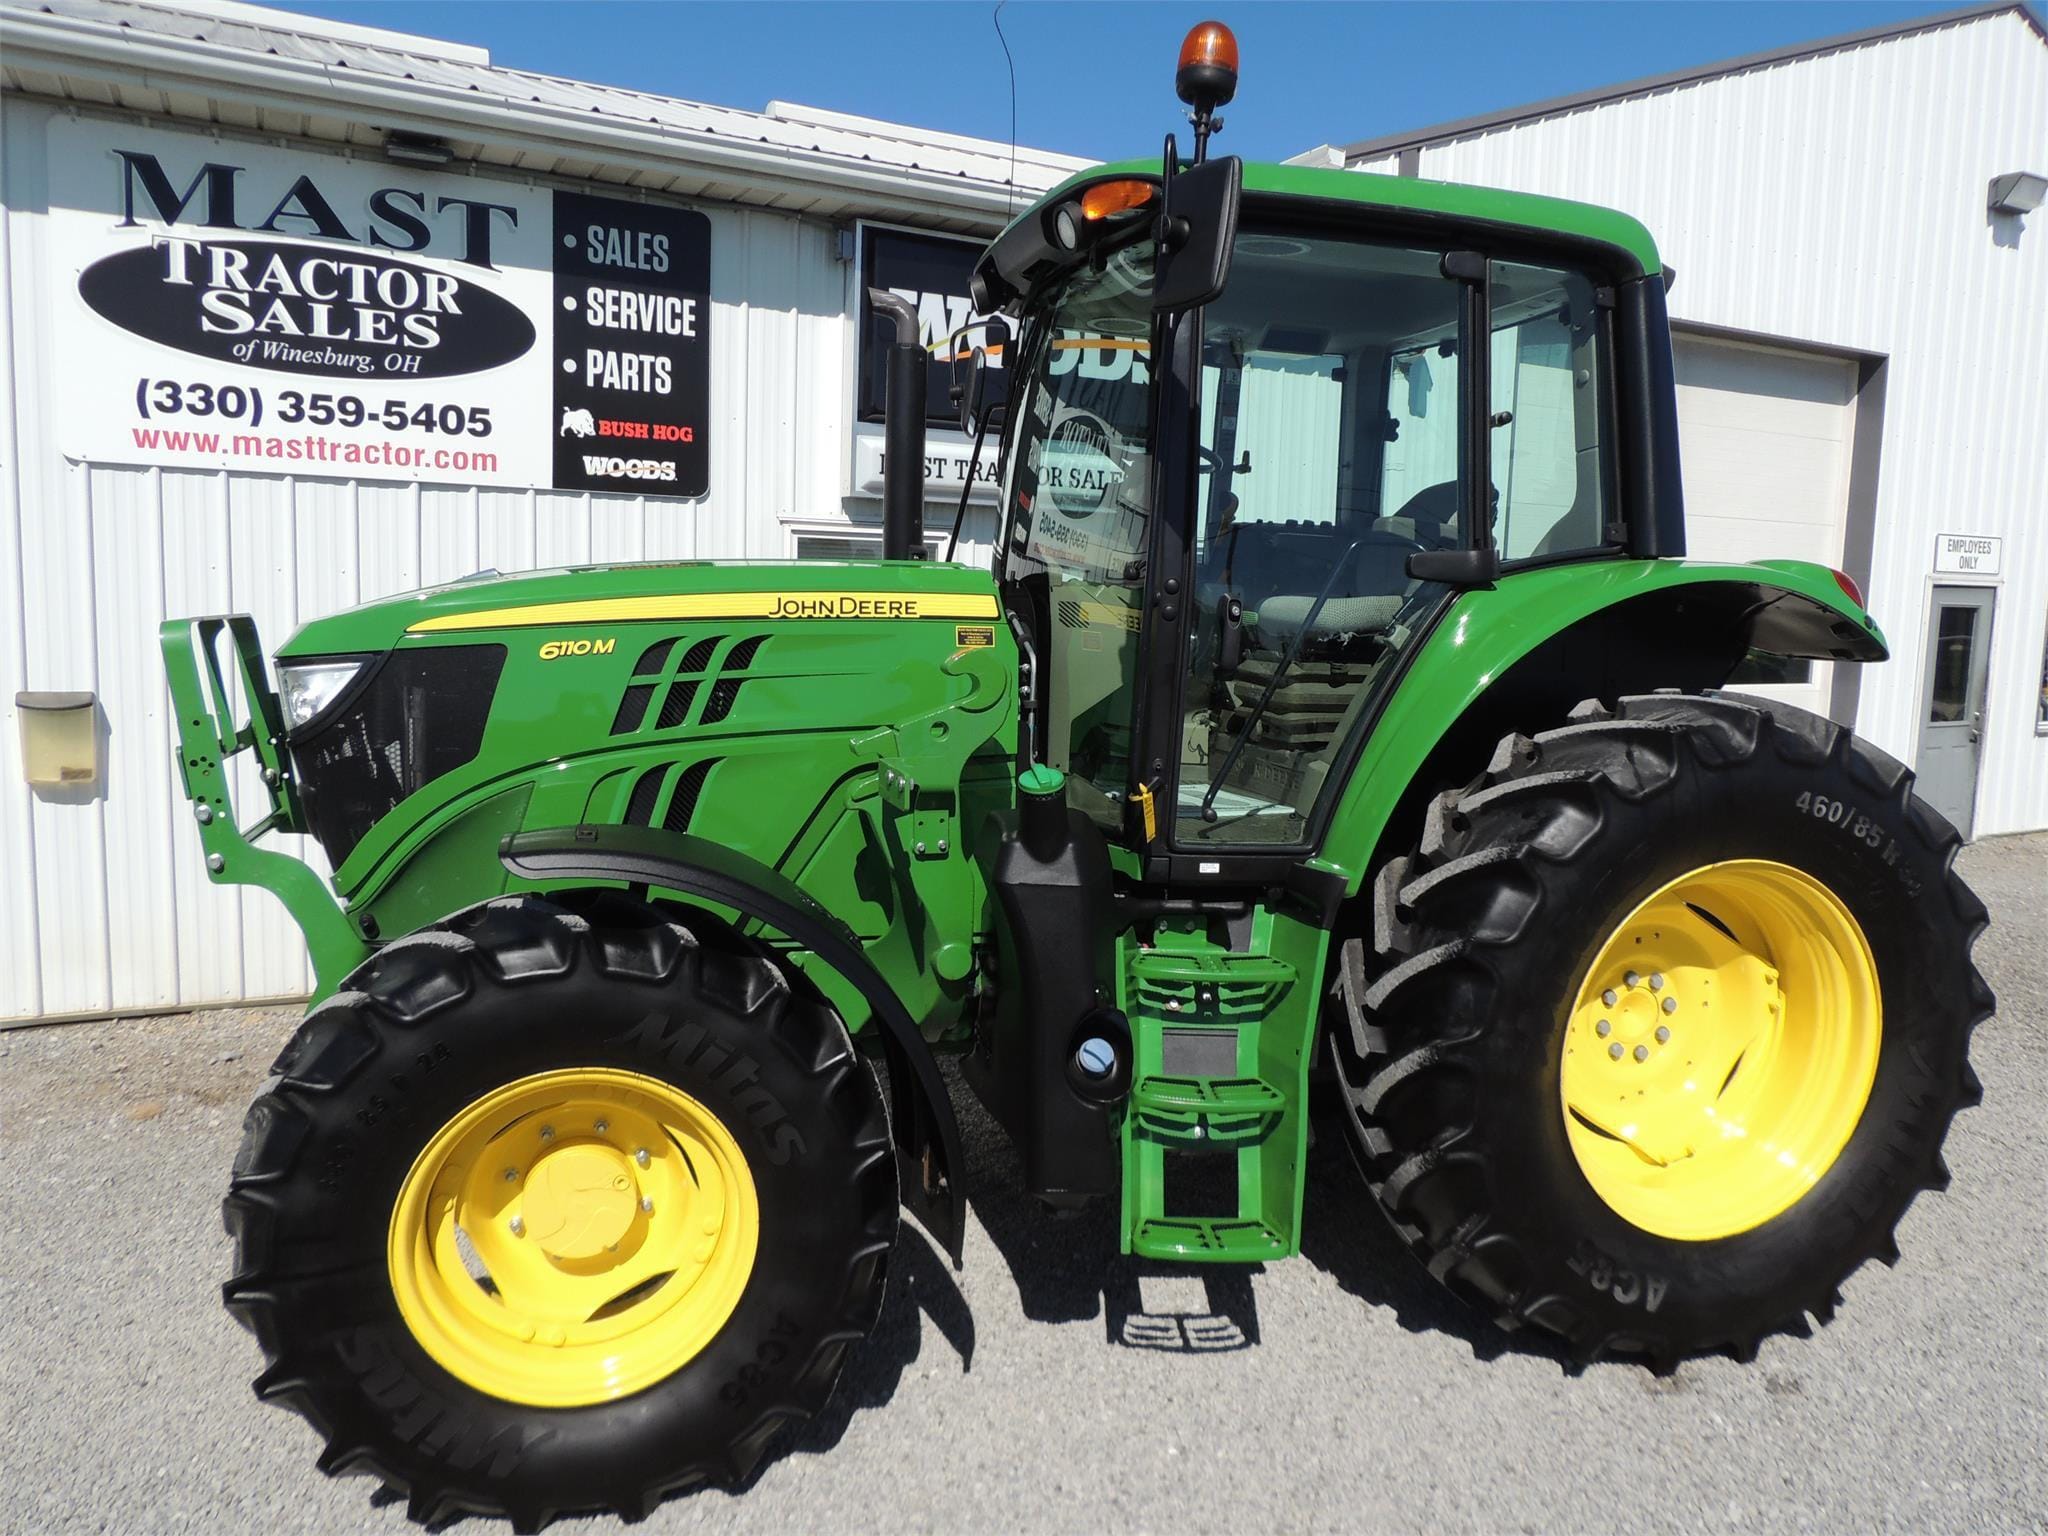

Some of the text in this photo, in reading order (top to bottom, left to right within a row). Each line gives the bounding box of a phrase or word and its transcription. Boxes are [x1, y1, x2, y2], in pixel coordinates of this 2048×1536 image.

[112, 148, 518, 273] MAST
[586, 225, 669, 272] SALES
[152, 234, 463, 315] TRACTOR
[201, 290, 440, 349] SALES
[586, 287, 696, 337] SERVICE
[233, 340, 422, 373] of Winesburg, OH
[586, 349, 672, 395] PARTS
[136, 378, 493, 438] (330) 359-5405
[598, 420, 693, 442] BUSH HOG
[132, 428, 498, 472] www.masttractor.com
[583, 456, 676, 481] WOODS
[1947, 538, 1992, 555] EMPLOYEES
[1958, 555, 1979, 570] ONLY
[769, 597, 918, 617] JOHN DEERE
[538, 637, 615, 660] 6110M
[1795, 791, 1885, 848] 460/85
[606, 1012, 807, 1166] Mitas
